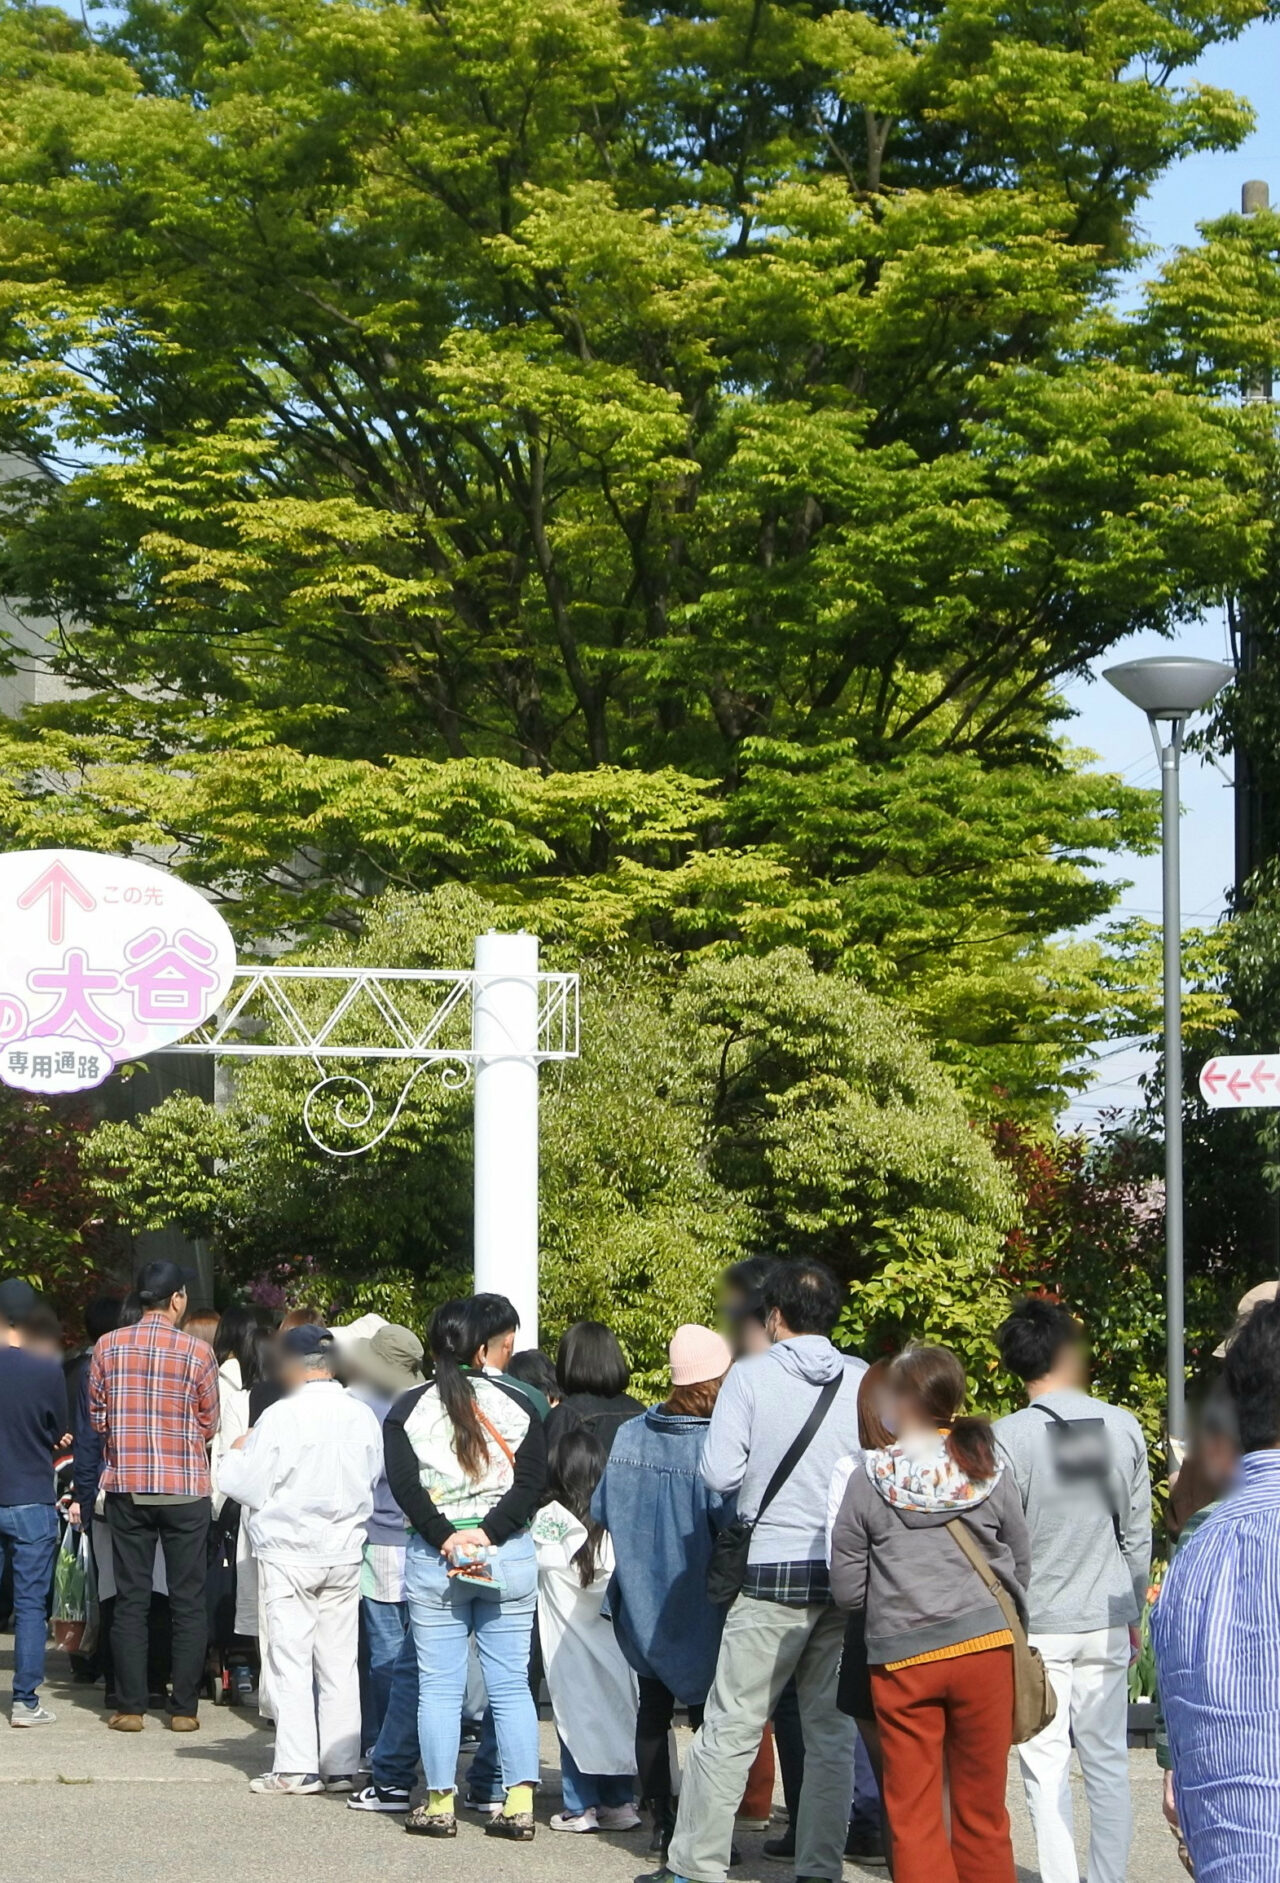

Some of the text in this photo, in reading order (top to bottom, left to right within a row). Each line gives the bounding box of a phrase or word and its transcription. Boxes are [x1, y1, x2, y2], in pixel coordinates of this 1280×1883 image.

[103, 885, 164, 906] この先
[7, 1050, 100, 1079] 専用通路
